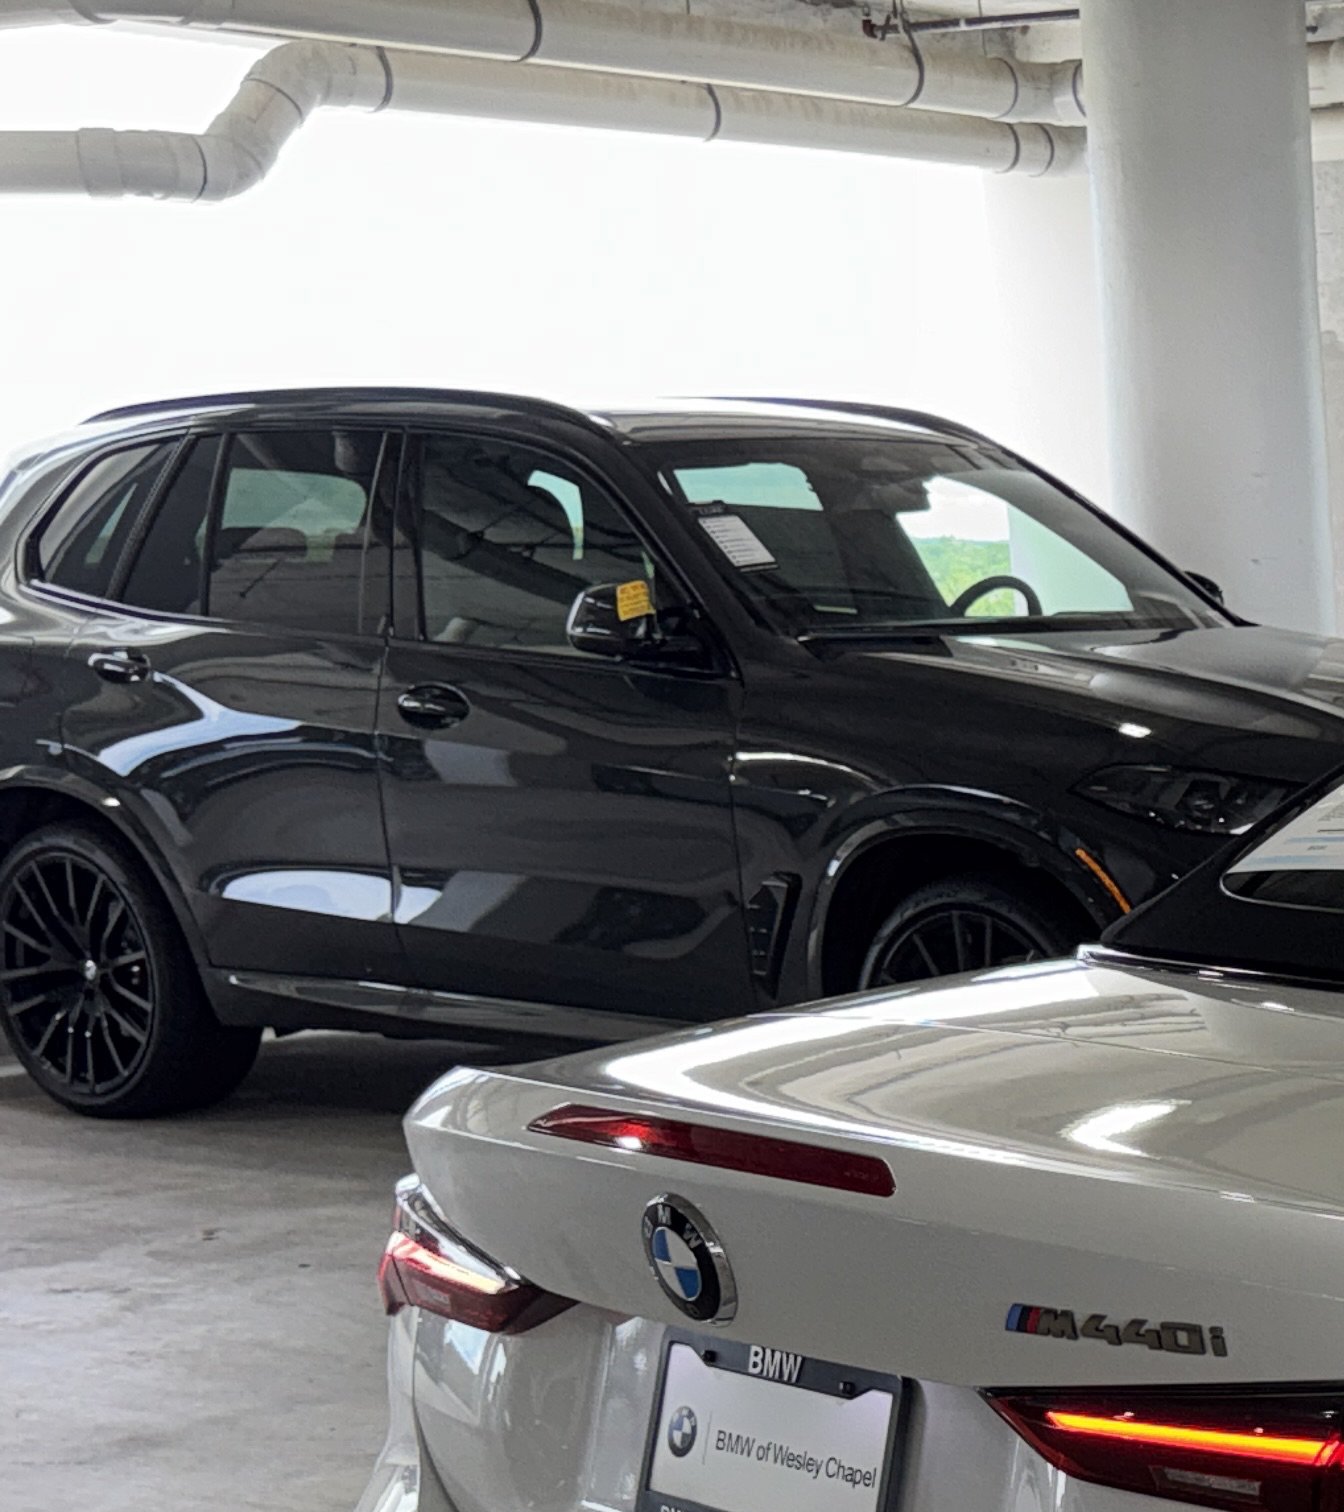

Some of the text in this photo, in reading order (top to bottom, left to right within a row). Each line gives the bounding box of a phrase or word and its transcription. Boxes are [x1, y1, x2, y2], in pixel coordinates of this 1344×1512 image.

[748, 1344, 802, 1383] BMW
[715, 1430, 877, 1489] BMW of Wesley Chapel
